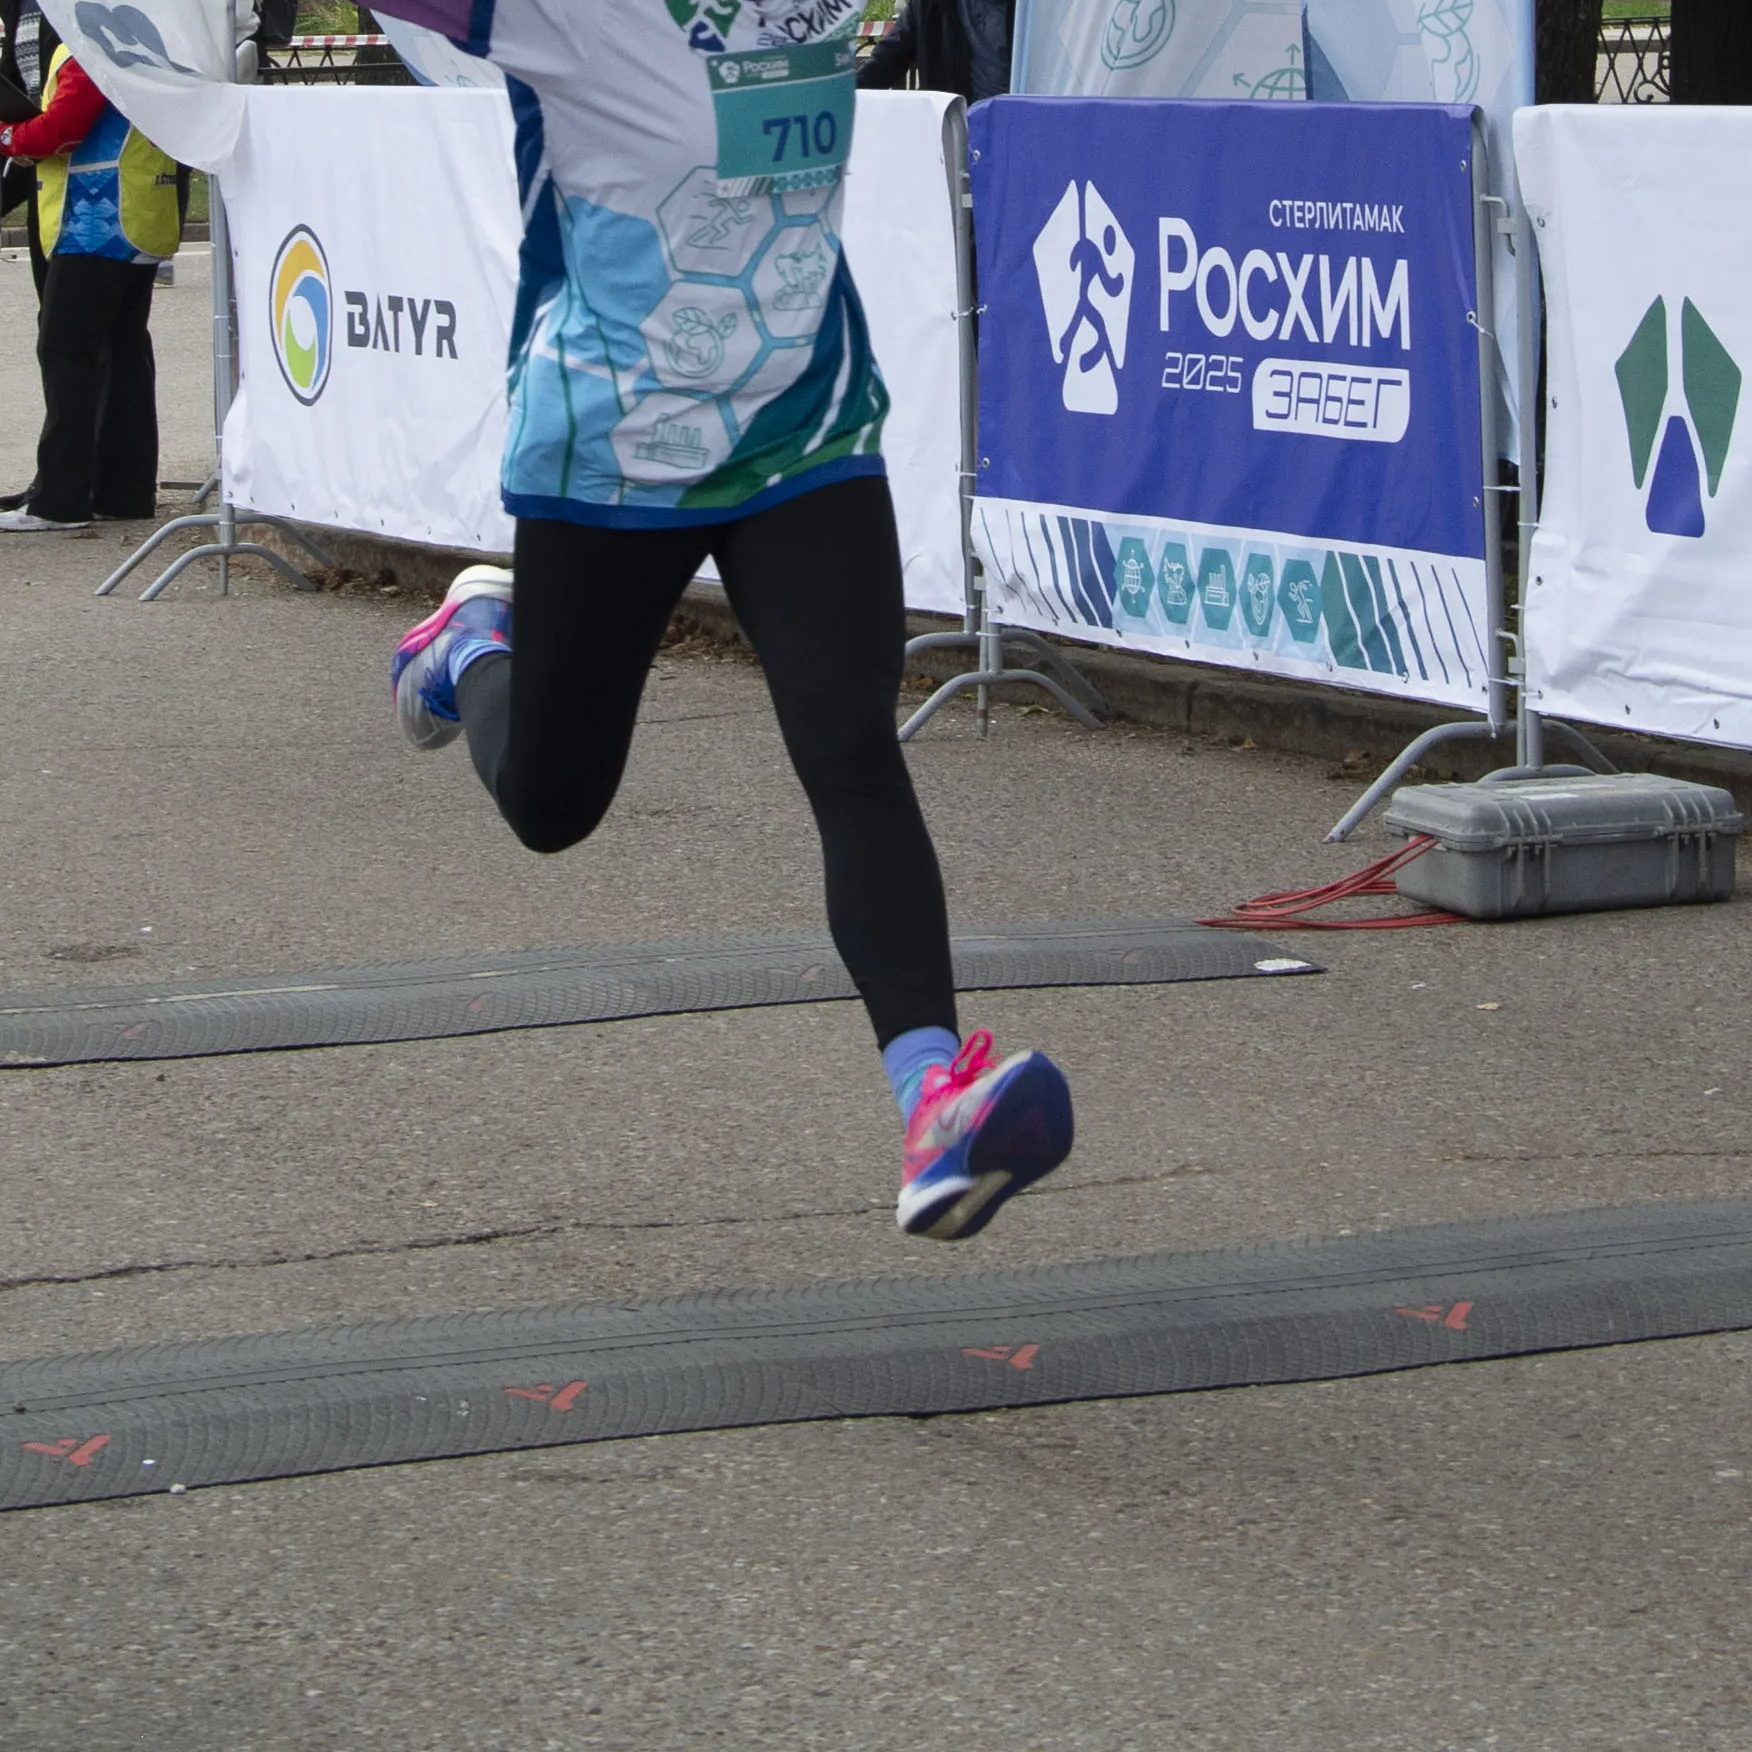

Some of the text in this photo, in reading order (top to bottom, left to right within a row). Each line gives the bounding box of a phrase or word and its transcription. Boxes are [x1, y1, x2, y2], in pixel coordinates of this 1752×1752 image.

[763, 110, 838, 163] 710
[1268, 198, 1405, 234] СТЕРЛИТАМАК
[344, 289, 459, 360] BATYR
[1161, 351, 1403, 430] 2025 ЗАБЕГ
